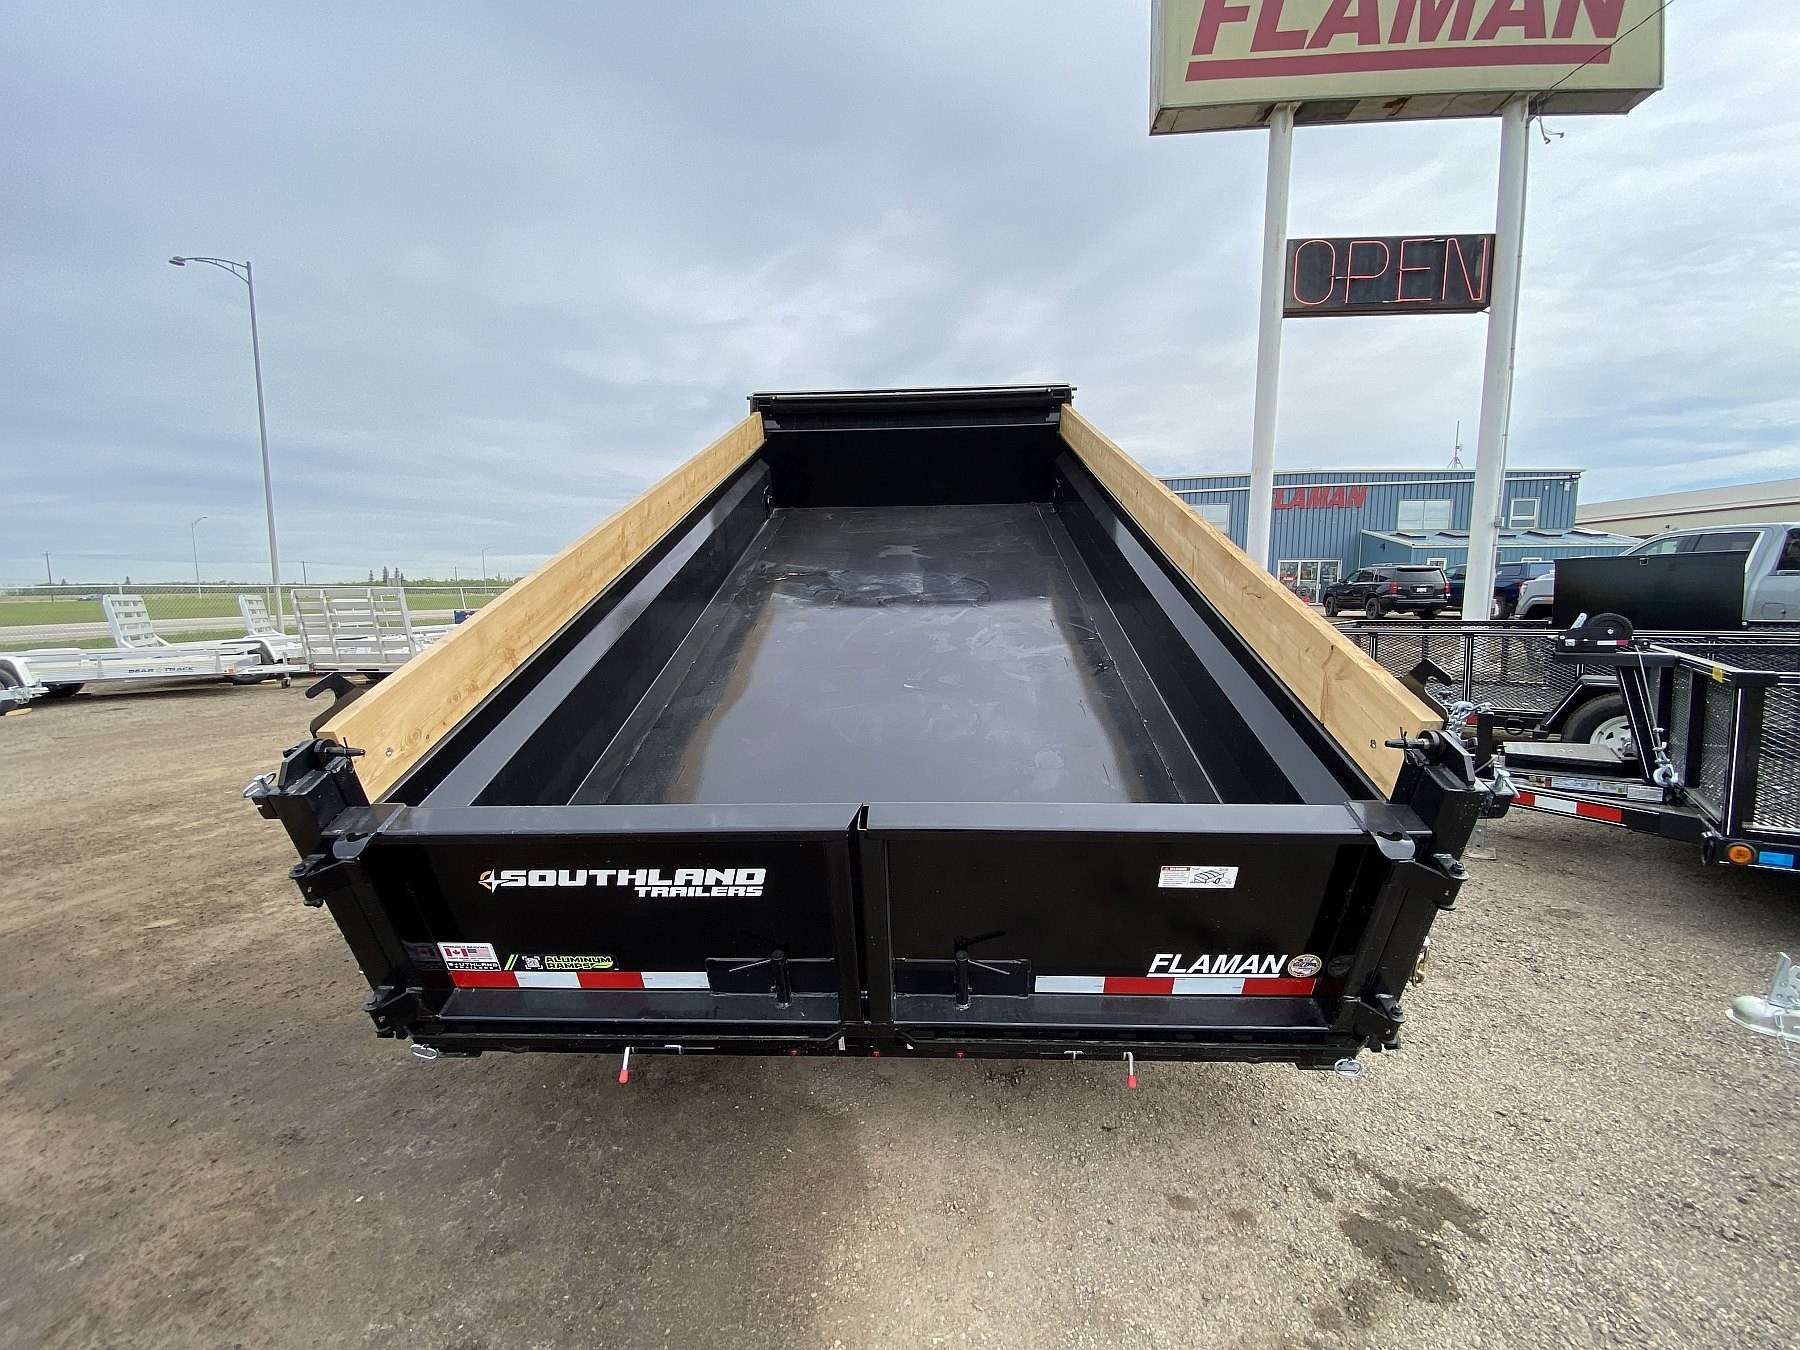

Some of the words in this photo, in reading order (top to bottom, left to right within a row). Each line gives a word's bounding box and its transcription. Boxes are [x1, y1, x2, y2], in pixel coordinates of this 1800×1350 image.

[1190, 0, 1625, 56] FLAMAN
[1293, 236, 1488, 306] OPEN
[1273, 486, 1368, 510] LAMAN
[165, 665, 194, 673] TRACK
[500, 868, 767, 887] SOUTHLAND
[634, 886, 763, 898] TRAILERS
[545, 956, 612, 964] ALUMINUM
[547, 962, 593, 970] RAMPS
[1148, 953, 1288, 974] FLAMAN
